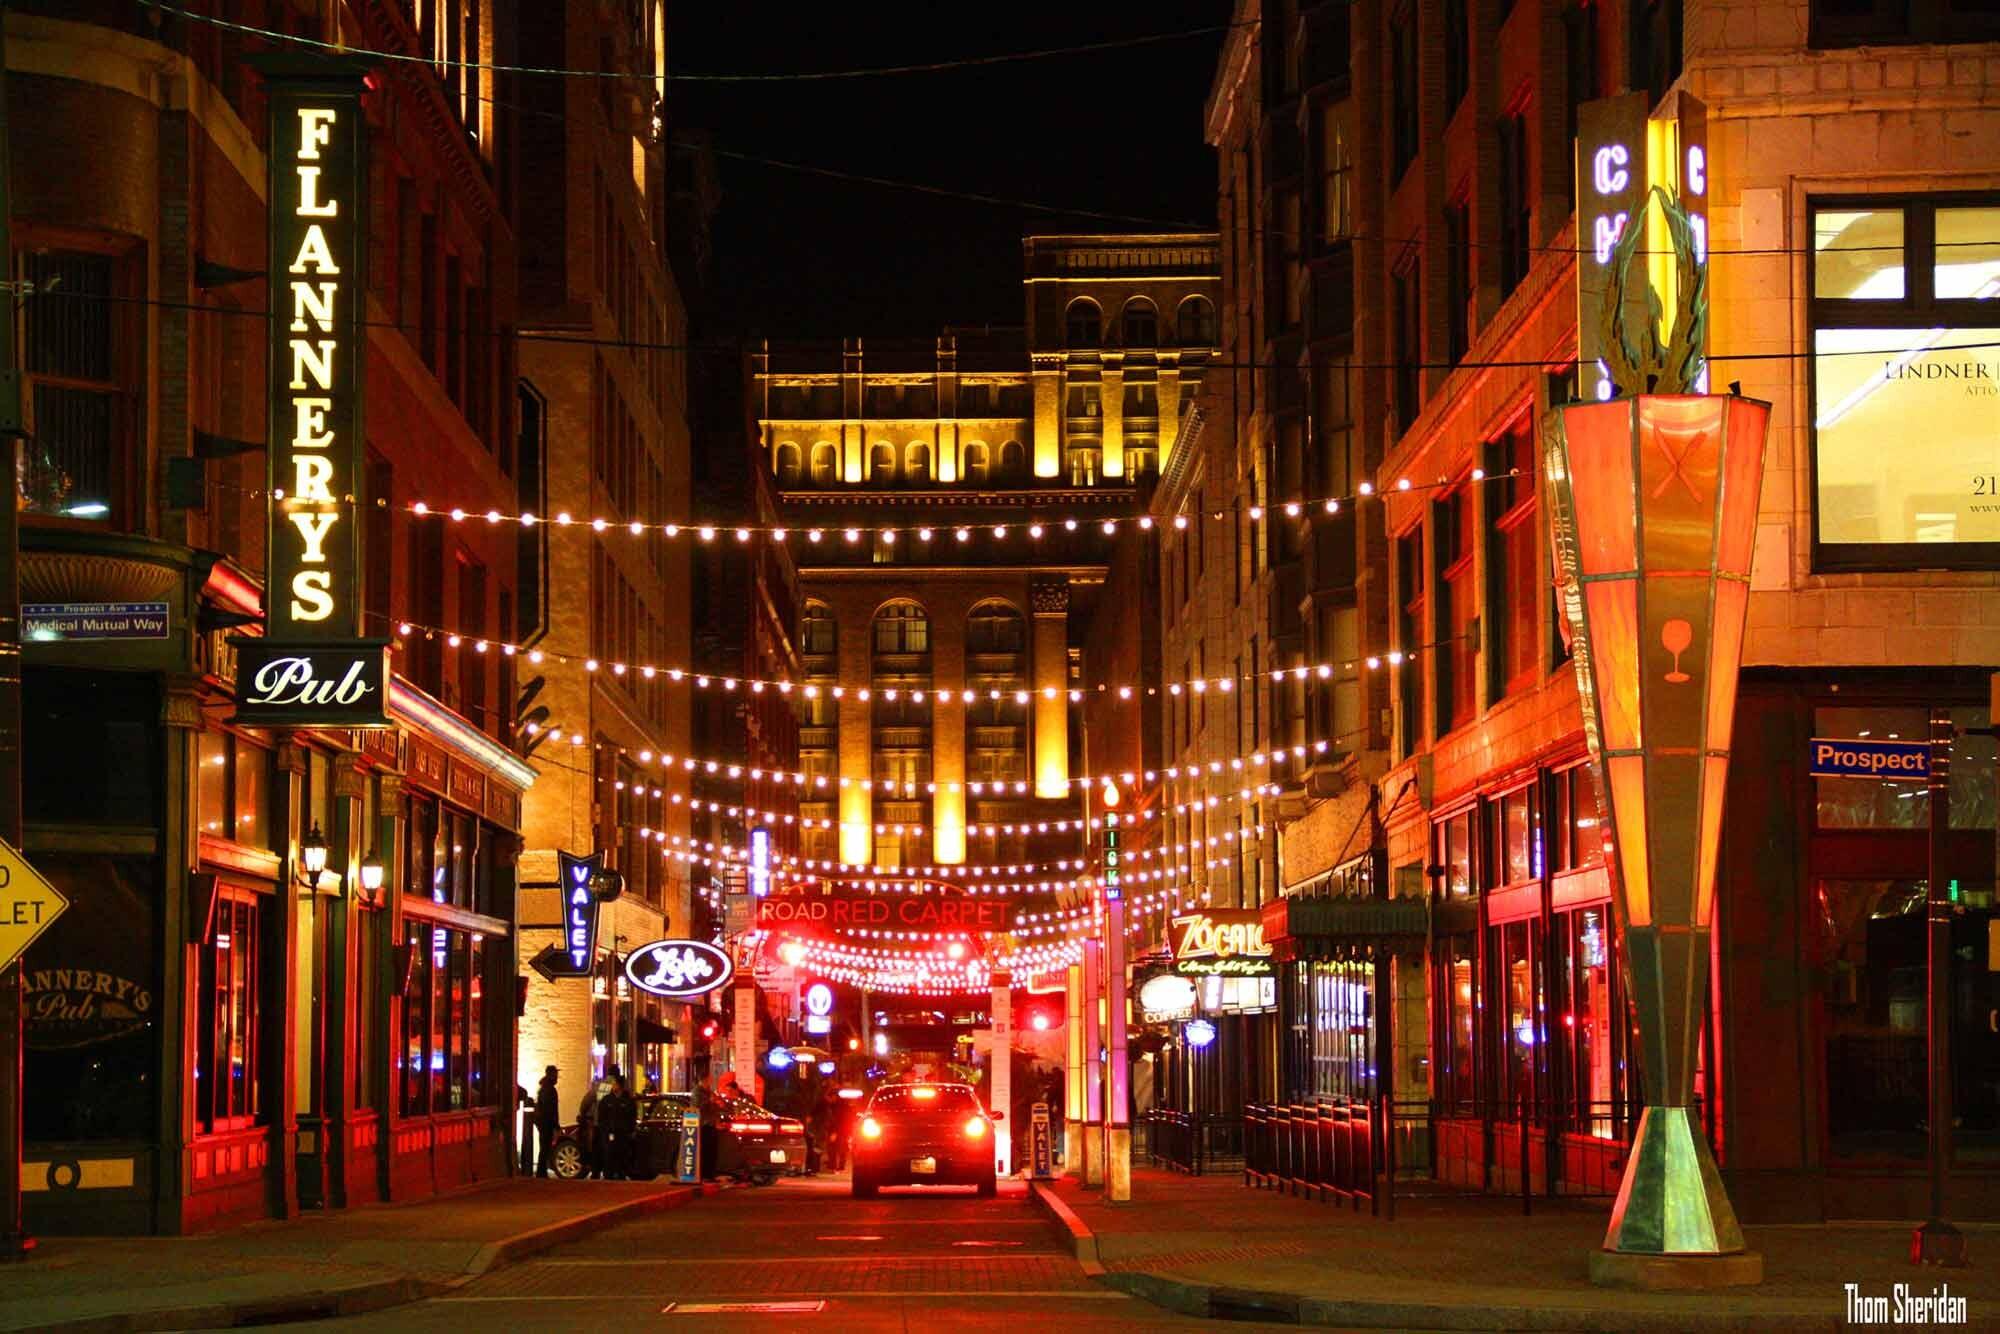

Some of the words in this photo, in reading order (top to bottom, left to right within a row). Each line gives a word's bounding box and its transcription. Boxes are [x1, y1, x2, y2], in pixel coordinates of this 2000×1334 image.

[288, 108, 341, 621] FLANNERYS
[1885, 361, 1990, 380] LINDNER
[64, 604, 105, 613] Prospect
[110, 604, 128, 612] Ave
[26, 619, 78, 632] Medical
[82, 618, 129, 631] Mutual
[133, 617, 163, 632] Way
[246, 657, 375, 705] Pub
[1816, 744, 1926, 773] Prospect
[572, 865, 589, 968] VALET
[761, 902, 828, 921] ROAD
[833, 901, 889, 922] RED
[899, 901, 1011, 924] CARPET
[36, 992, 94, 1021] Pub
[684, 1127, 696, 1175] VALET
